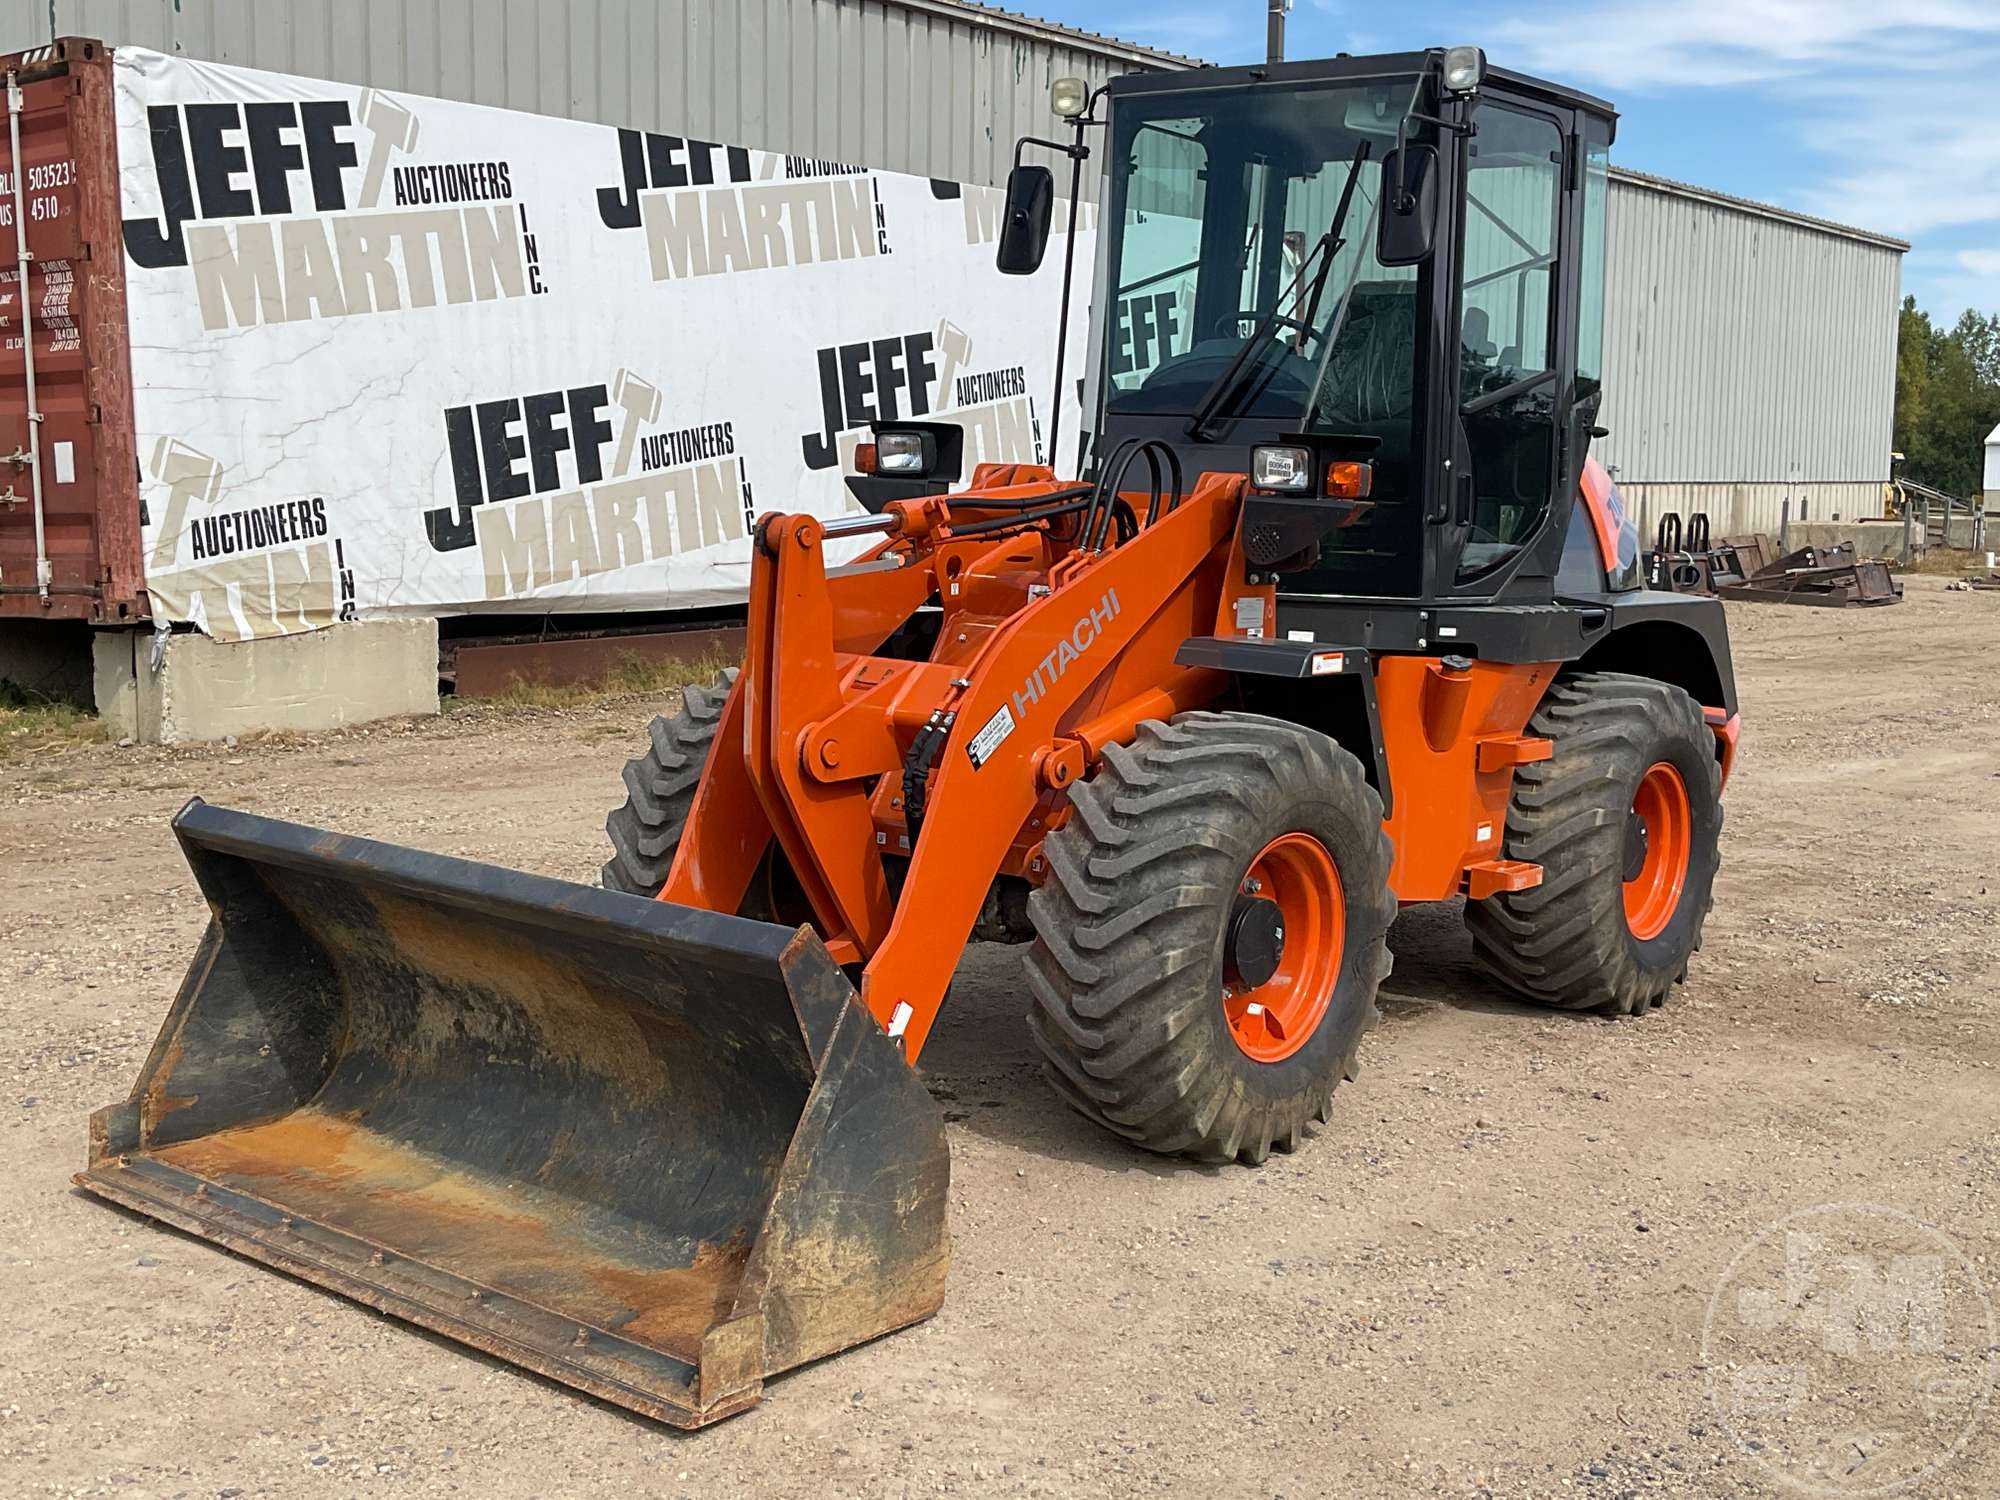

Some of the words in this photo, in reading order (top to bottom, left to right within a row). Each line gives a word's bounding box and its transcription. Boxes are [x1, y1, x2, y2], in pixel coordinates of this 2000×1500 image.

[29, 162, 70, 191] 503523
[31, 196, 58, 221] 4510
[122, 101, 358, 268] JEFF
[394, 161, 512, 205] AUCTIONEERS
[187, 205, 526, 330] MARTIN
[642, 178, 876, 281] MARTIN
[801, 331, 937, 470] JEFF
[956, 366, 1025, 407] AUCTIONEERS
[424, 384, 613, 552] JEFF
[641, 422, 735, 471] AUCTIONEERS
[191, 498, 328, 560] AUCTIONEERS
[477, 459, 743, 600] MARTIN
[1012, 587, 1121, 719] HITACHI
